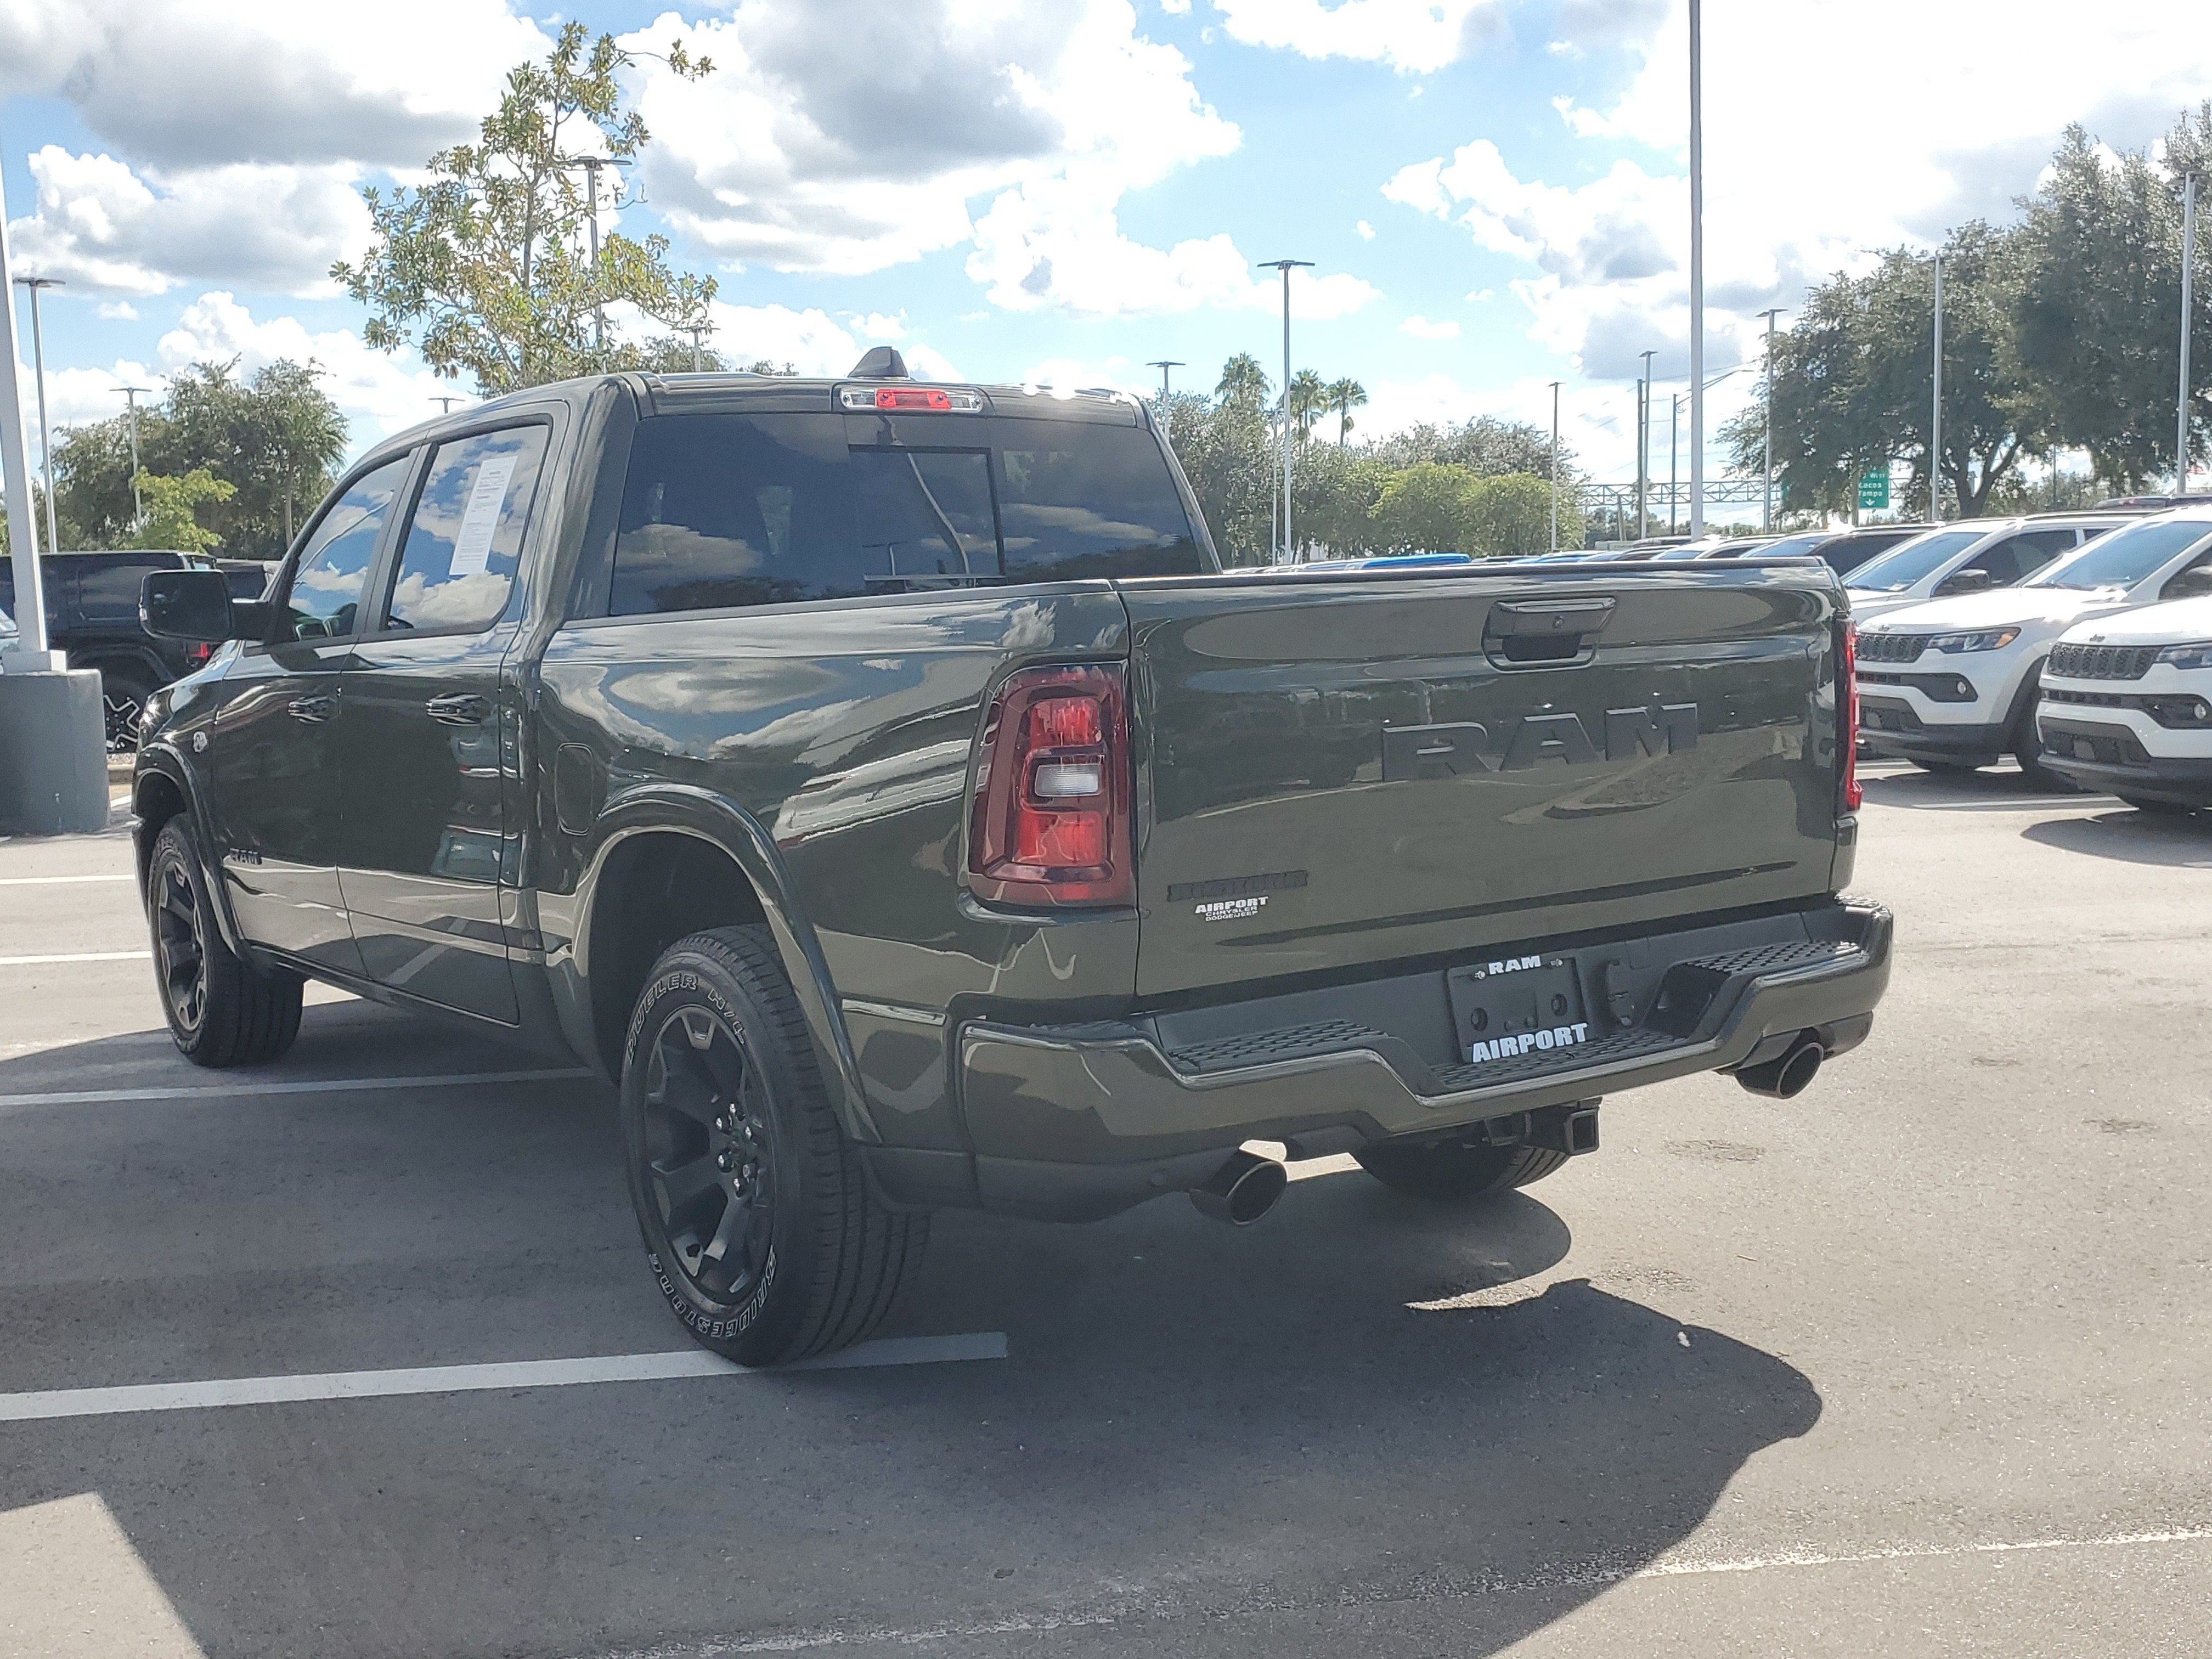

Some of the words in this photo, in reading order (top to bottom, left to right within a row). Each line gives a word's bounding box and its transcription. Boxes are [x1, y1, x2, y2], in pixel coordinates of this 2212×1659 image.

[1382, 703, 1698, 782] RAM
[228, 847, 262, 865] RAM
[1195, 896, 1269, 914] AIRPORT
[1205, 906, 1258, 917] CHRYSLER
[1487, 955, 1542, 975] RAM
[627, 973, 698, 1065] DUELER
[1472, 1023, 1588, 1063] AIRPORT
[648, 1244, 777, 1338] BRIDGESTONE
